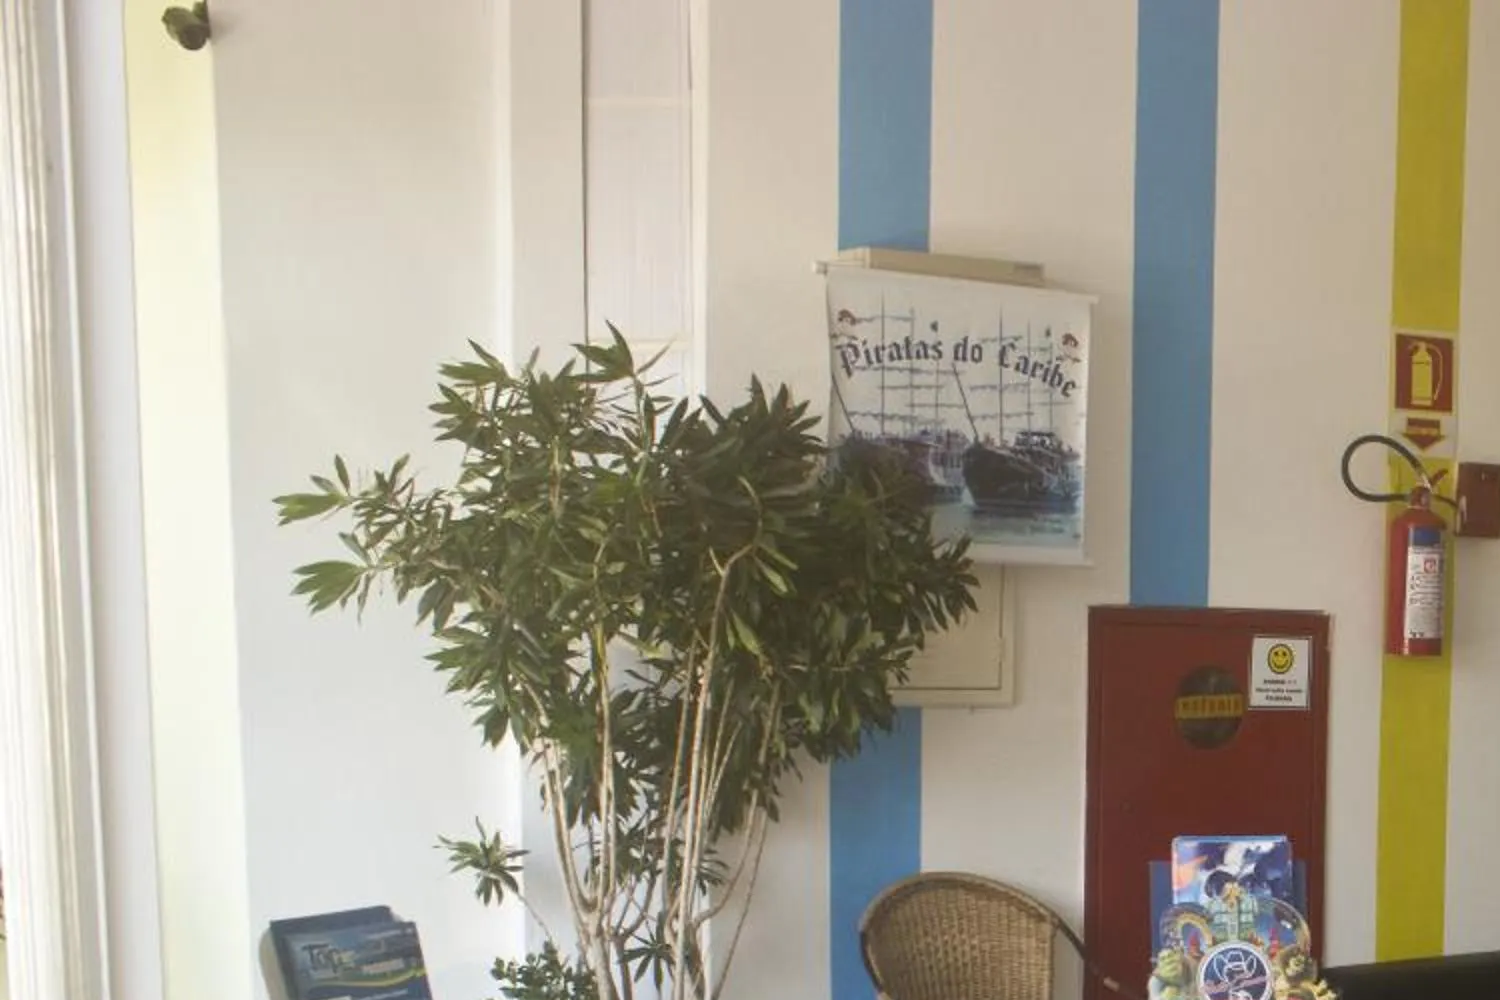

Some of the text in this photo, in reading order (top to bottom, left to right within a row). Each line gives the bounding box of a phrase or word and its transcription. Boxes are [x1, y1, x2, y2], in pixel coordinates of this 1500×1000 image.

[836, 334, 1078, 399] Piratas do Caribe
[302, 943, 345, 973] Top
